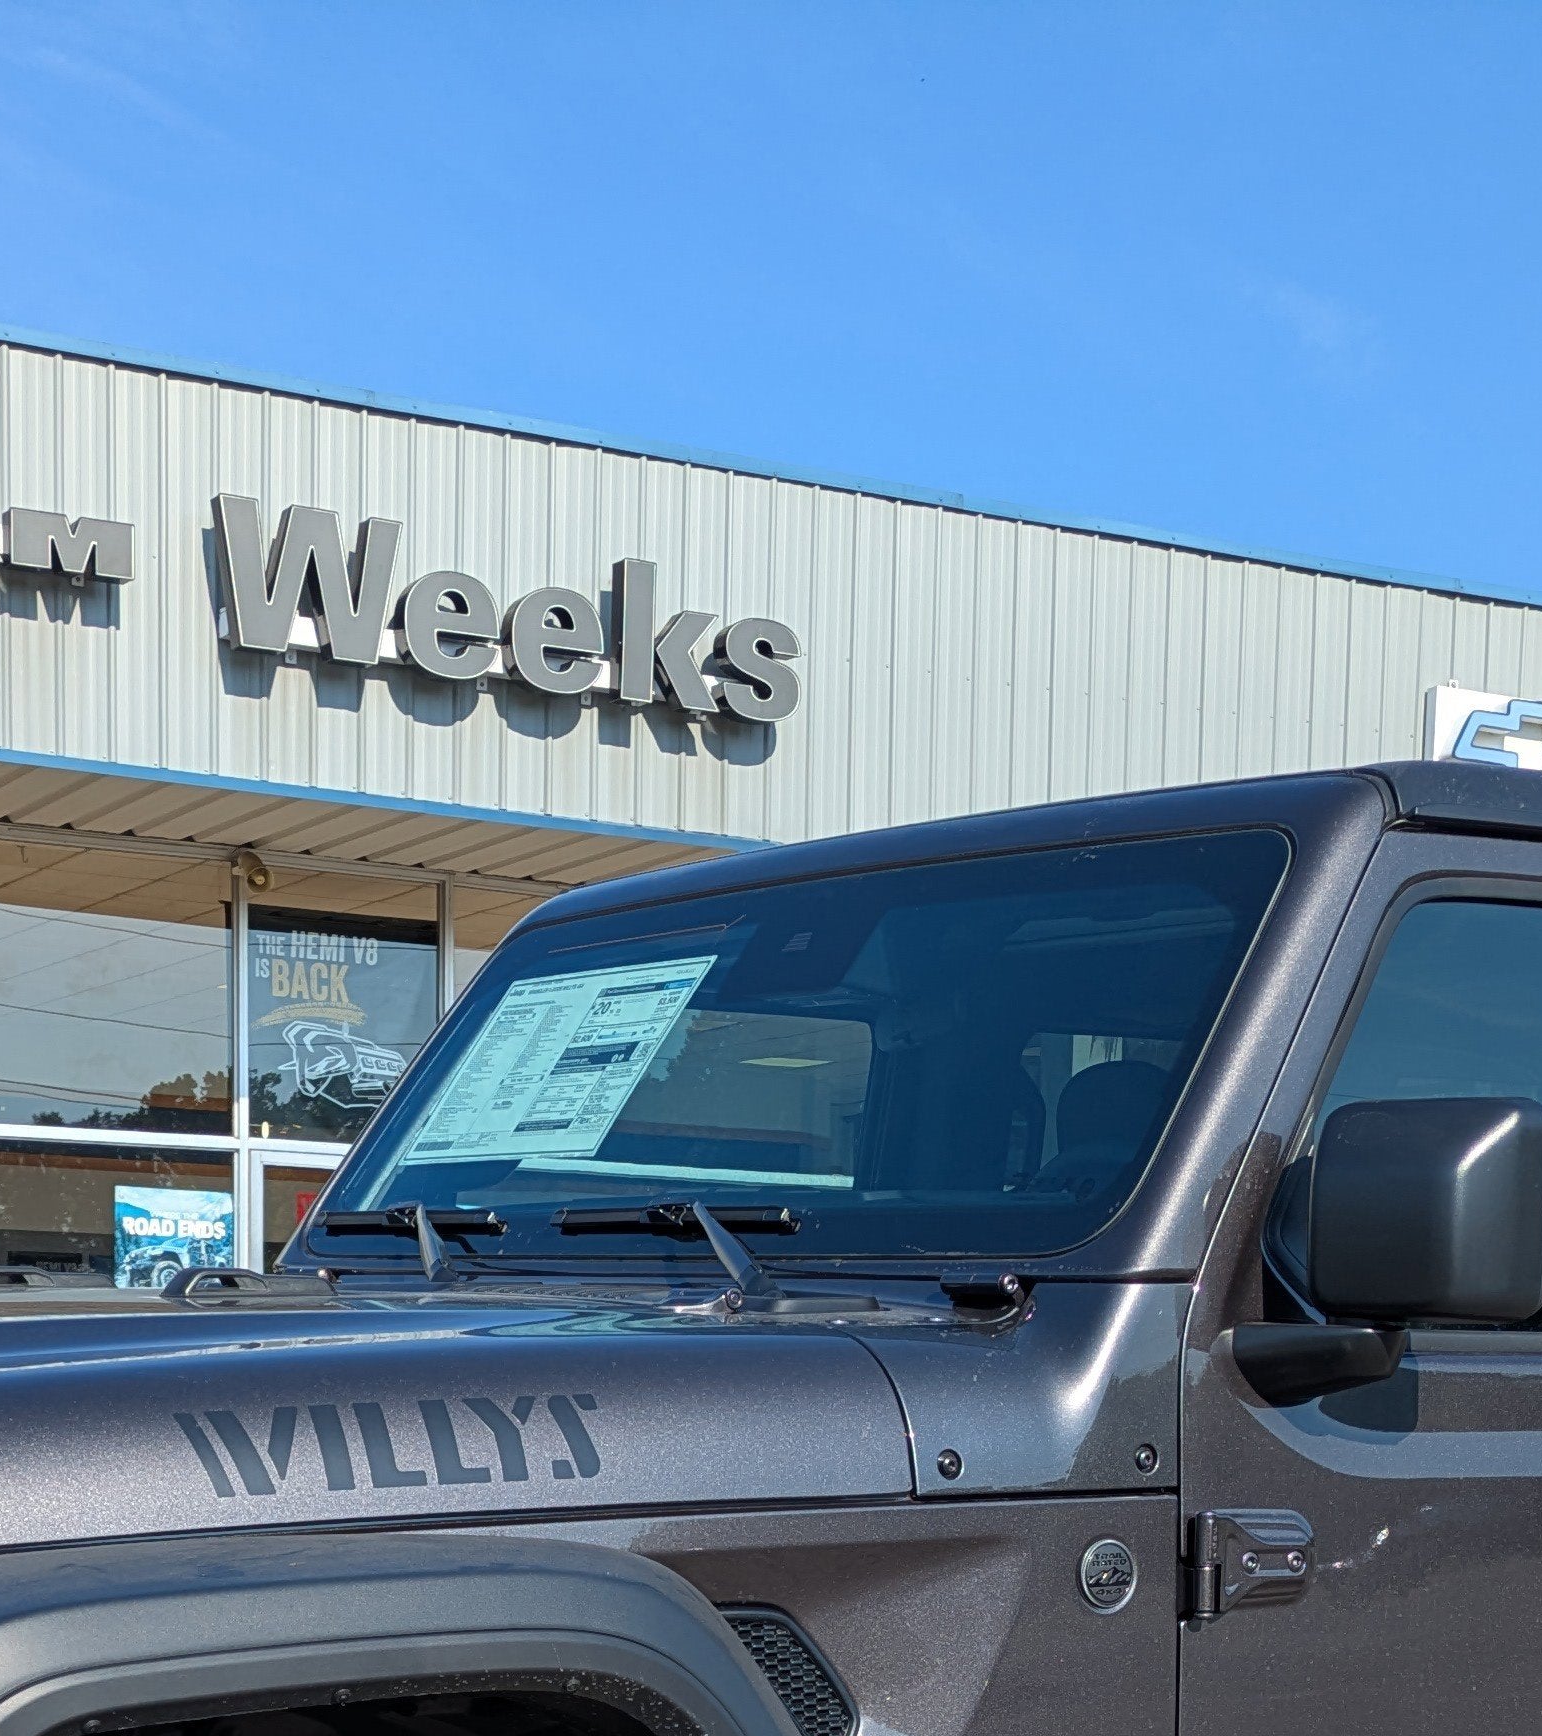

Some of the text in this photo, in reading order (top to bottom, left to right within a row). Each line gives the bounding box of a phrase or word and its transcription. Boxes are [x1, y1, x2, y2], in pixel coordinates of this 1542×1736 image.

[211, 492, 803, 725] Weeks
[256, 930, 378, 965] THE HEMI V8
[255, 957, 349, 1003] IS BACK
[122, 1216, 226, 1239] ROAD ENDS
[172, 1394, 601, 1498] WILLYS
[1092, 1559, 1127, 1567] RATED
[1094, 1552, 1124, 1560] TRAIL
